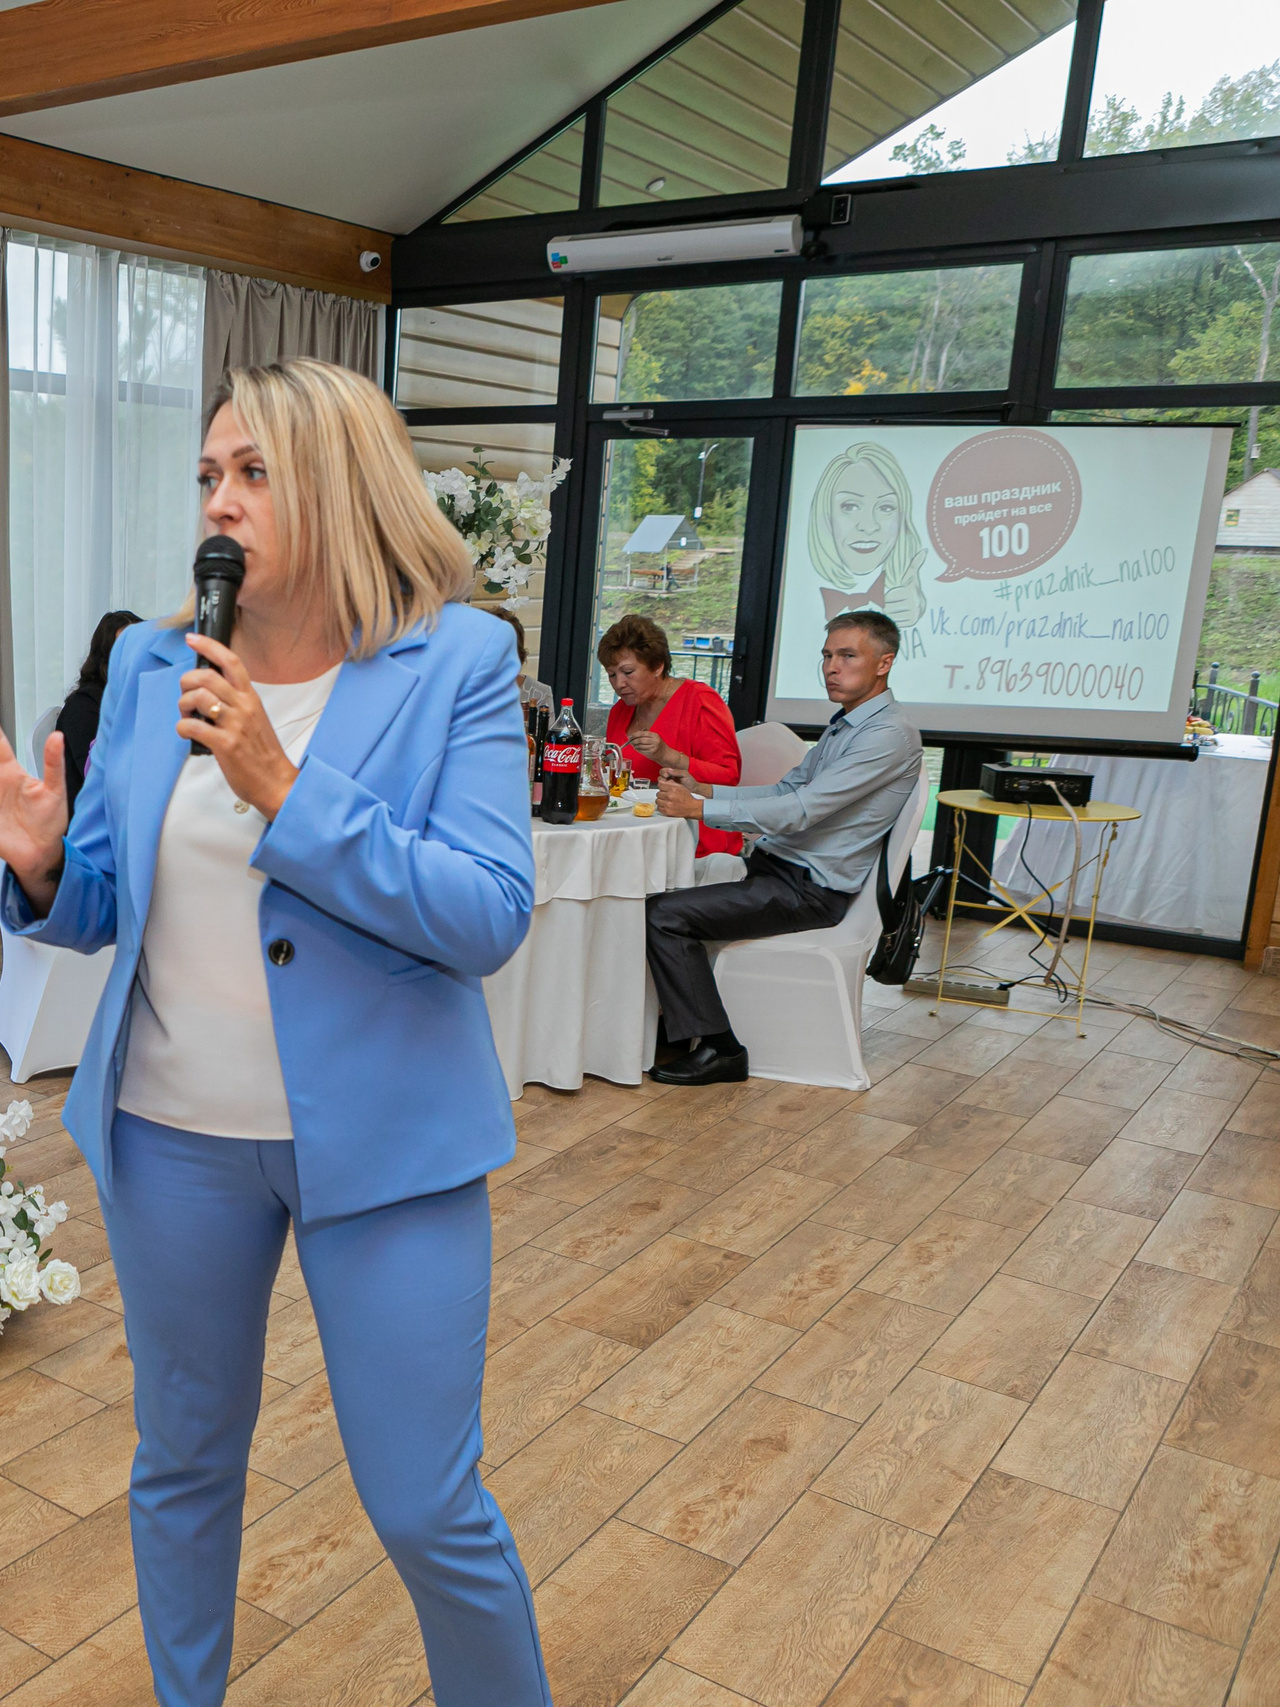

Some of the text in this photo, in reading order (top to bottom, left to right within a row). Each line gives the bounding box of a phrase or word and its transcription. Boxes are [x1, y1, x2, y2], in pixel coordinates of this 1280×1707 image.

[944, 481, 1062, 508] ваш праздник
[954, 502, 1053, 526] пройдет на все
[979, 522, 1030, 559] 100
[543, 745, 581, 763] Coca-Cola
